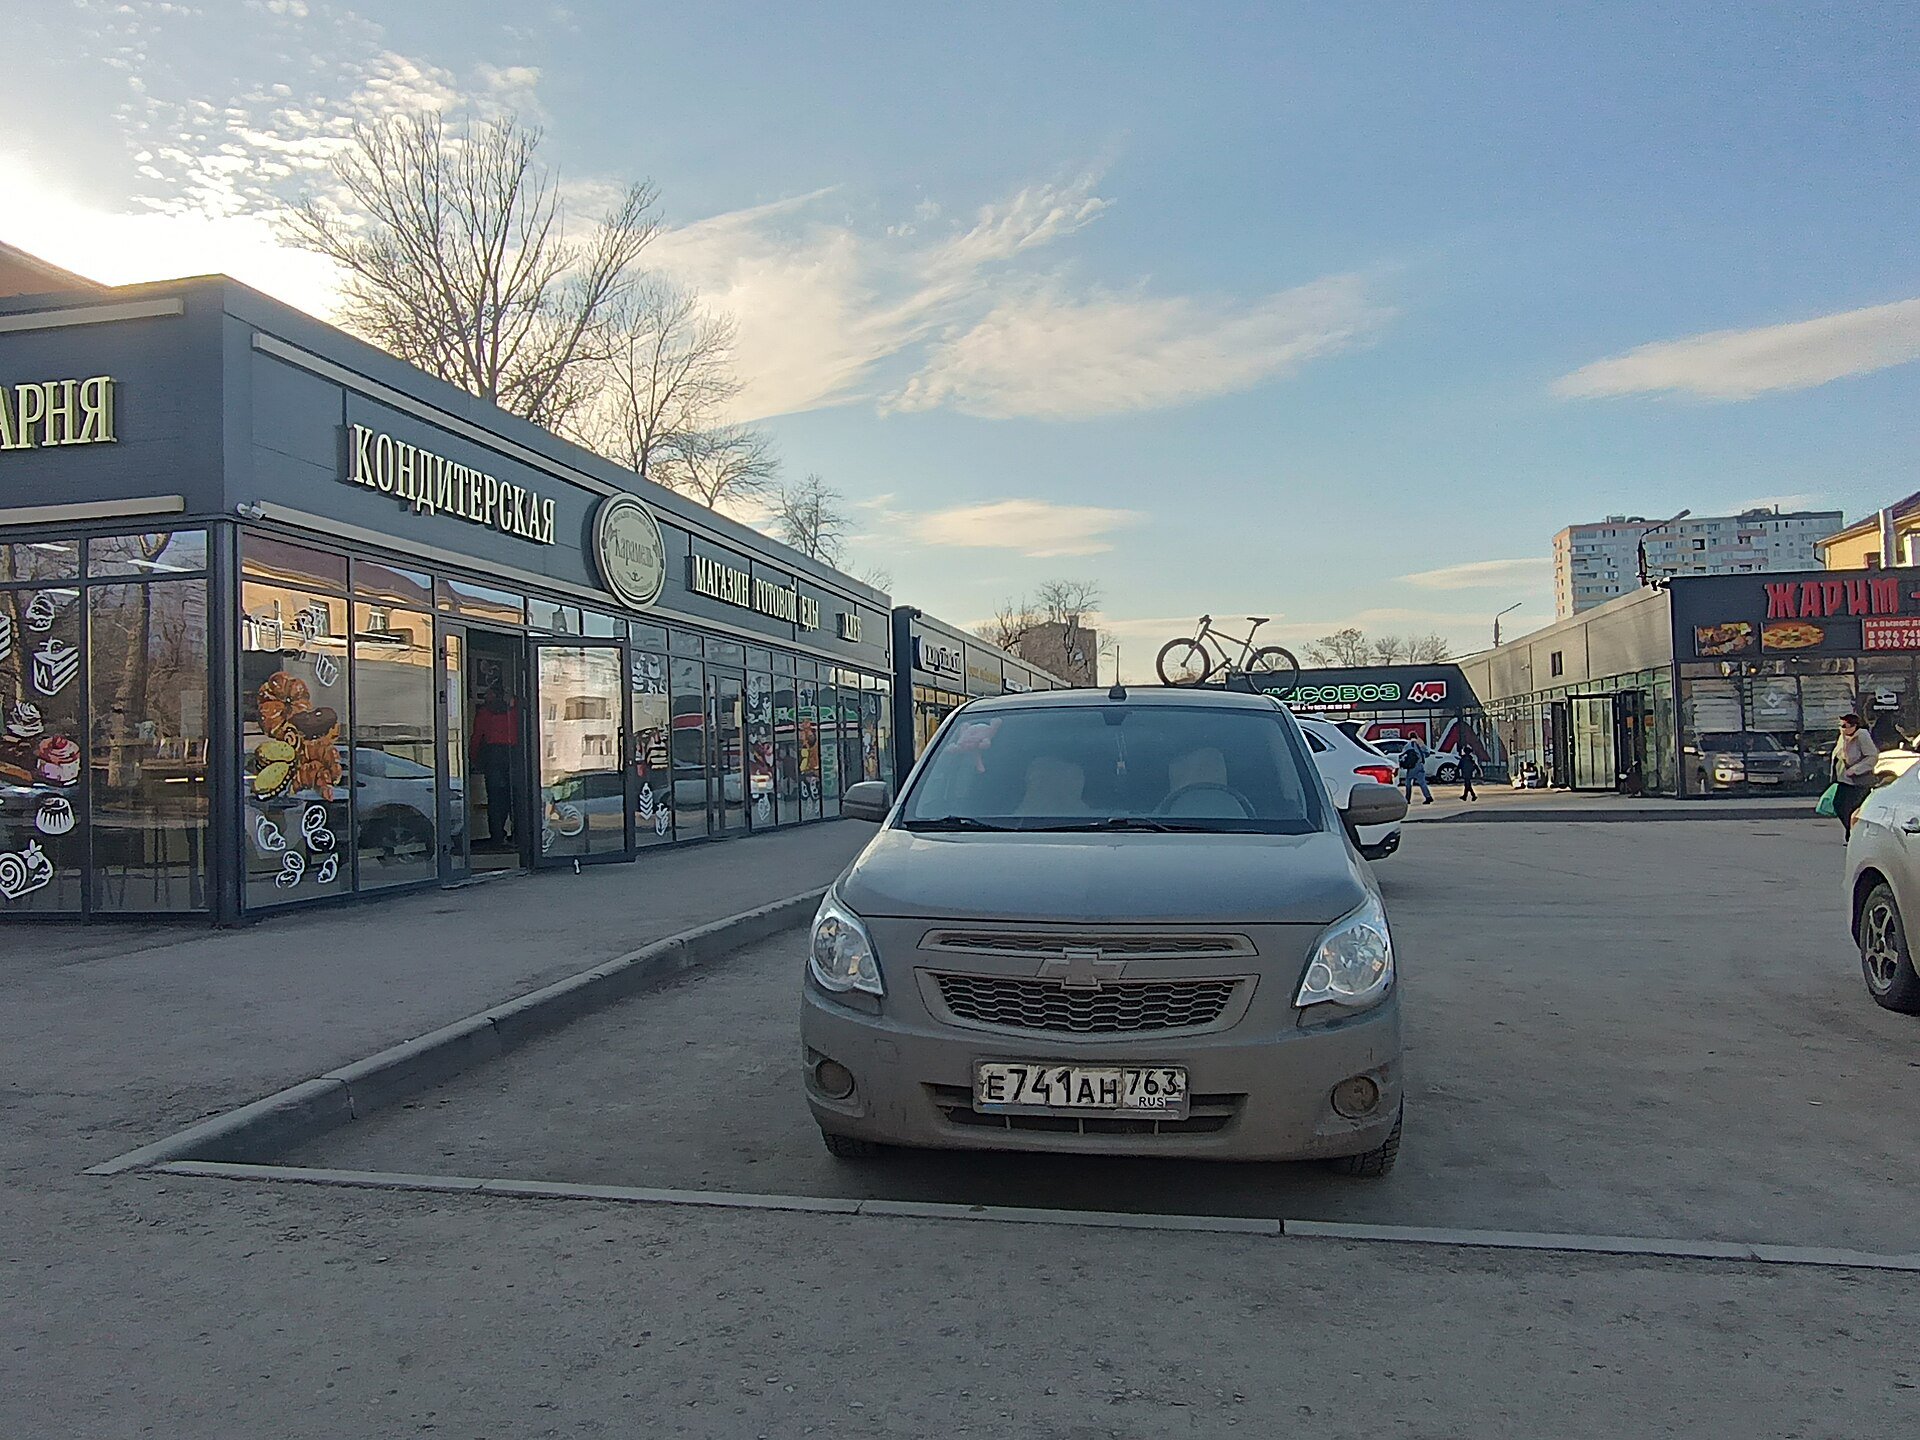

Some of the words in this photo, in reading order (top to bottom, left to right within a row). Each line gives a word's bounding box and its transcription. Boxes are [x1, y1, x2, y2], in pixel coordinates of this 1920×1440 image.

[353, 423, 556, 545] КОНДИТЕРСКАЯ
[694, 554, 750, 608] МАГАЗИН
[755, 577, 797, 623] ГОТОВОЙ
[801, 595, 819, 632] ЕДЫ
[1765, 578, 1899, 618] ЖАРИМ
[987, 1068, 1117, 1104] Е741АН
[1126, 1070, 1177, 1096] 763
[1138, 1096, 1164, 1107] RUS
